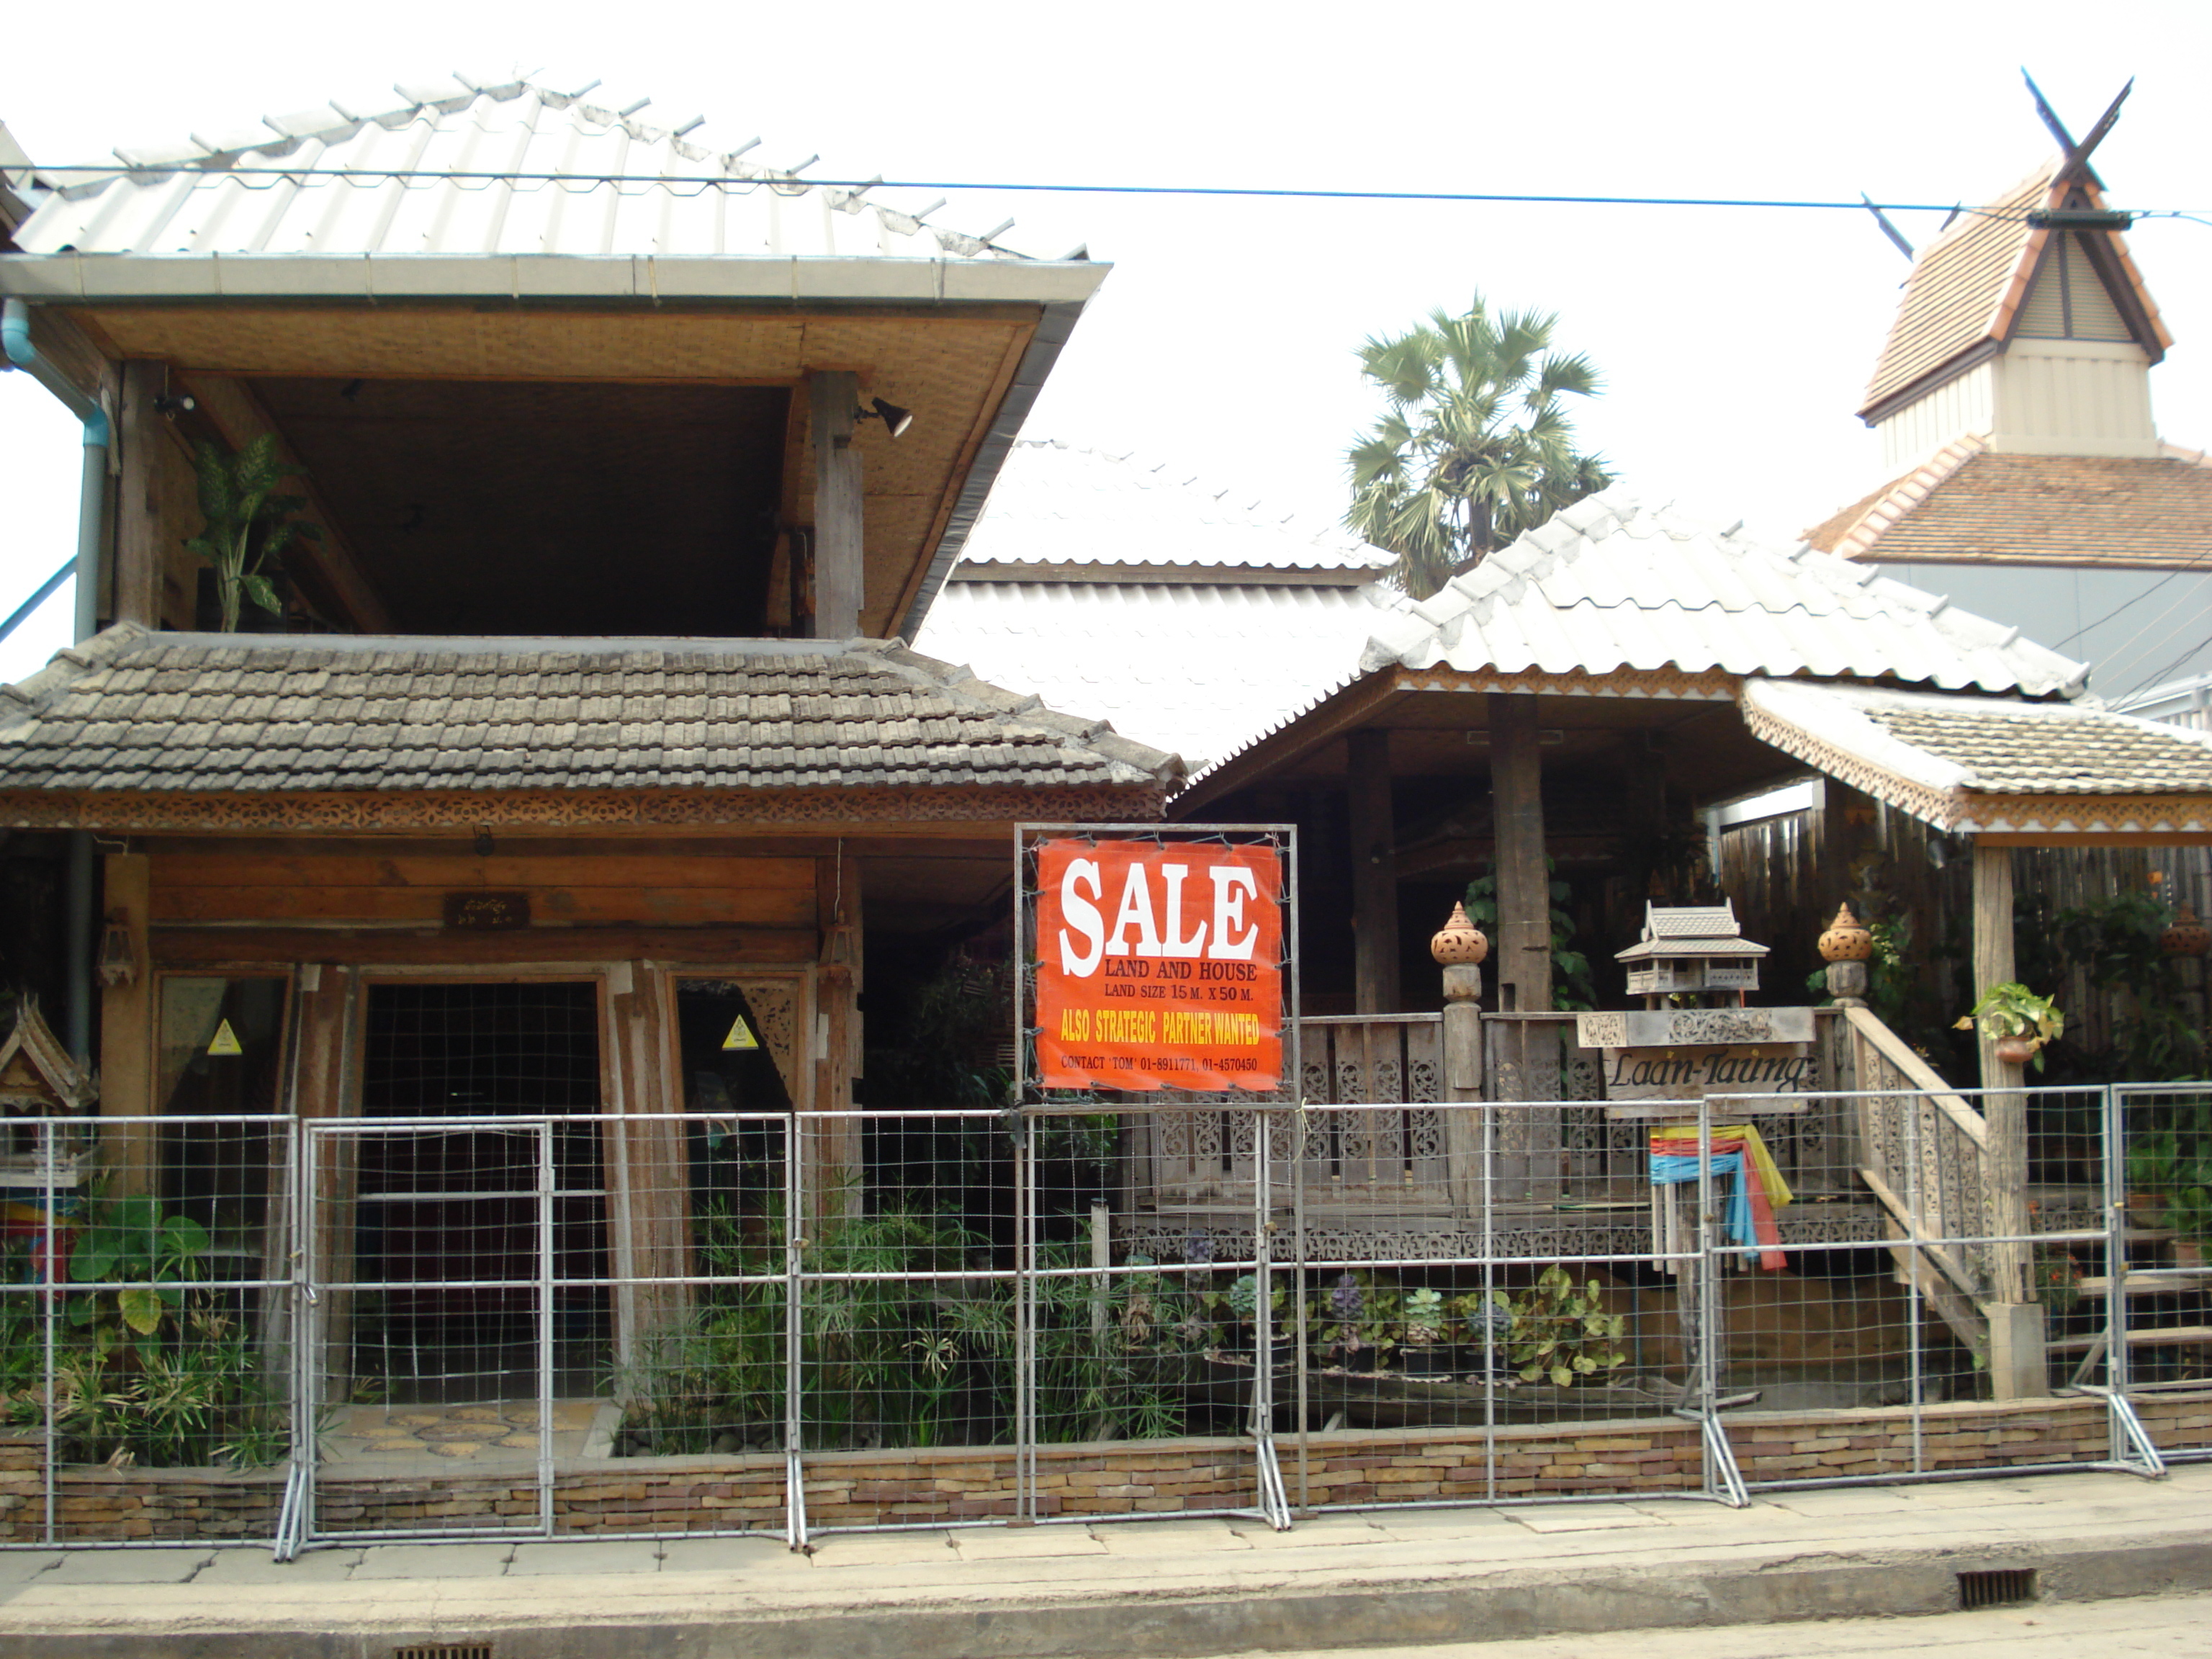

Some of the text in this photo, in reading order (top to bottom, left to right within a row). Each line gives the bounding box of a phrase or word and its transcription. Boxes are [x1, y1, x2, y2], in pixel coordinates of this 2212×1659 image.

[1058, 858, 1259, 978] SALE
[1105, 958, 1257, 981] LAND AND HOUSE
[1105, 984, 1136, 997] LAND
[1141, 985, 1166, 999] SIZE
[1171, 984, 1187, 999] 15
[1190, 986, 1203, 1000] M.
[1220, 986, 1237, 1001] 50
[1240, 988, 1254, 1002] M.
[1061, 1008, 1260, 1046] ALSO STRATEGIC PARTNER WANTED
[1061, 1056, 1105, 1069] CONTACT
[1202, 1058, 1257, 1071] 01-4570450
[1609, 1051, 1807, 1093] Laan-Taung
